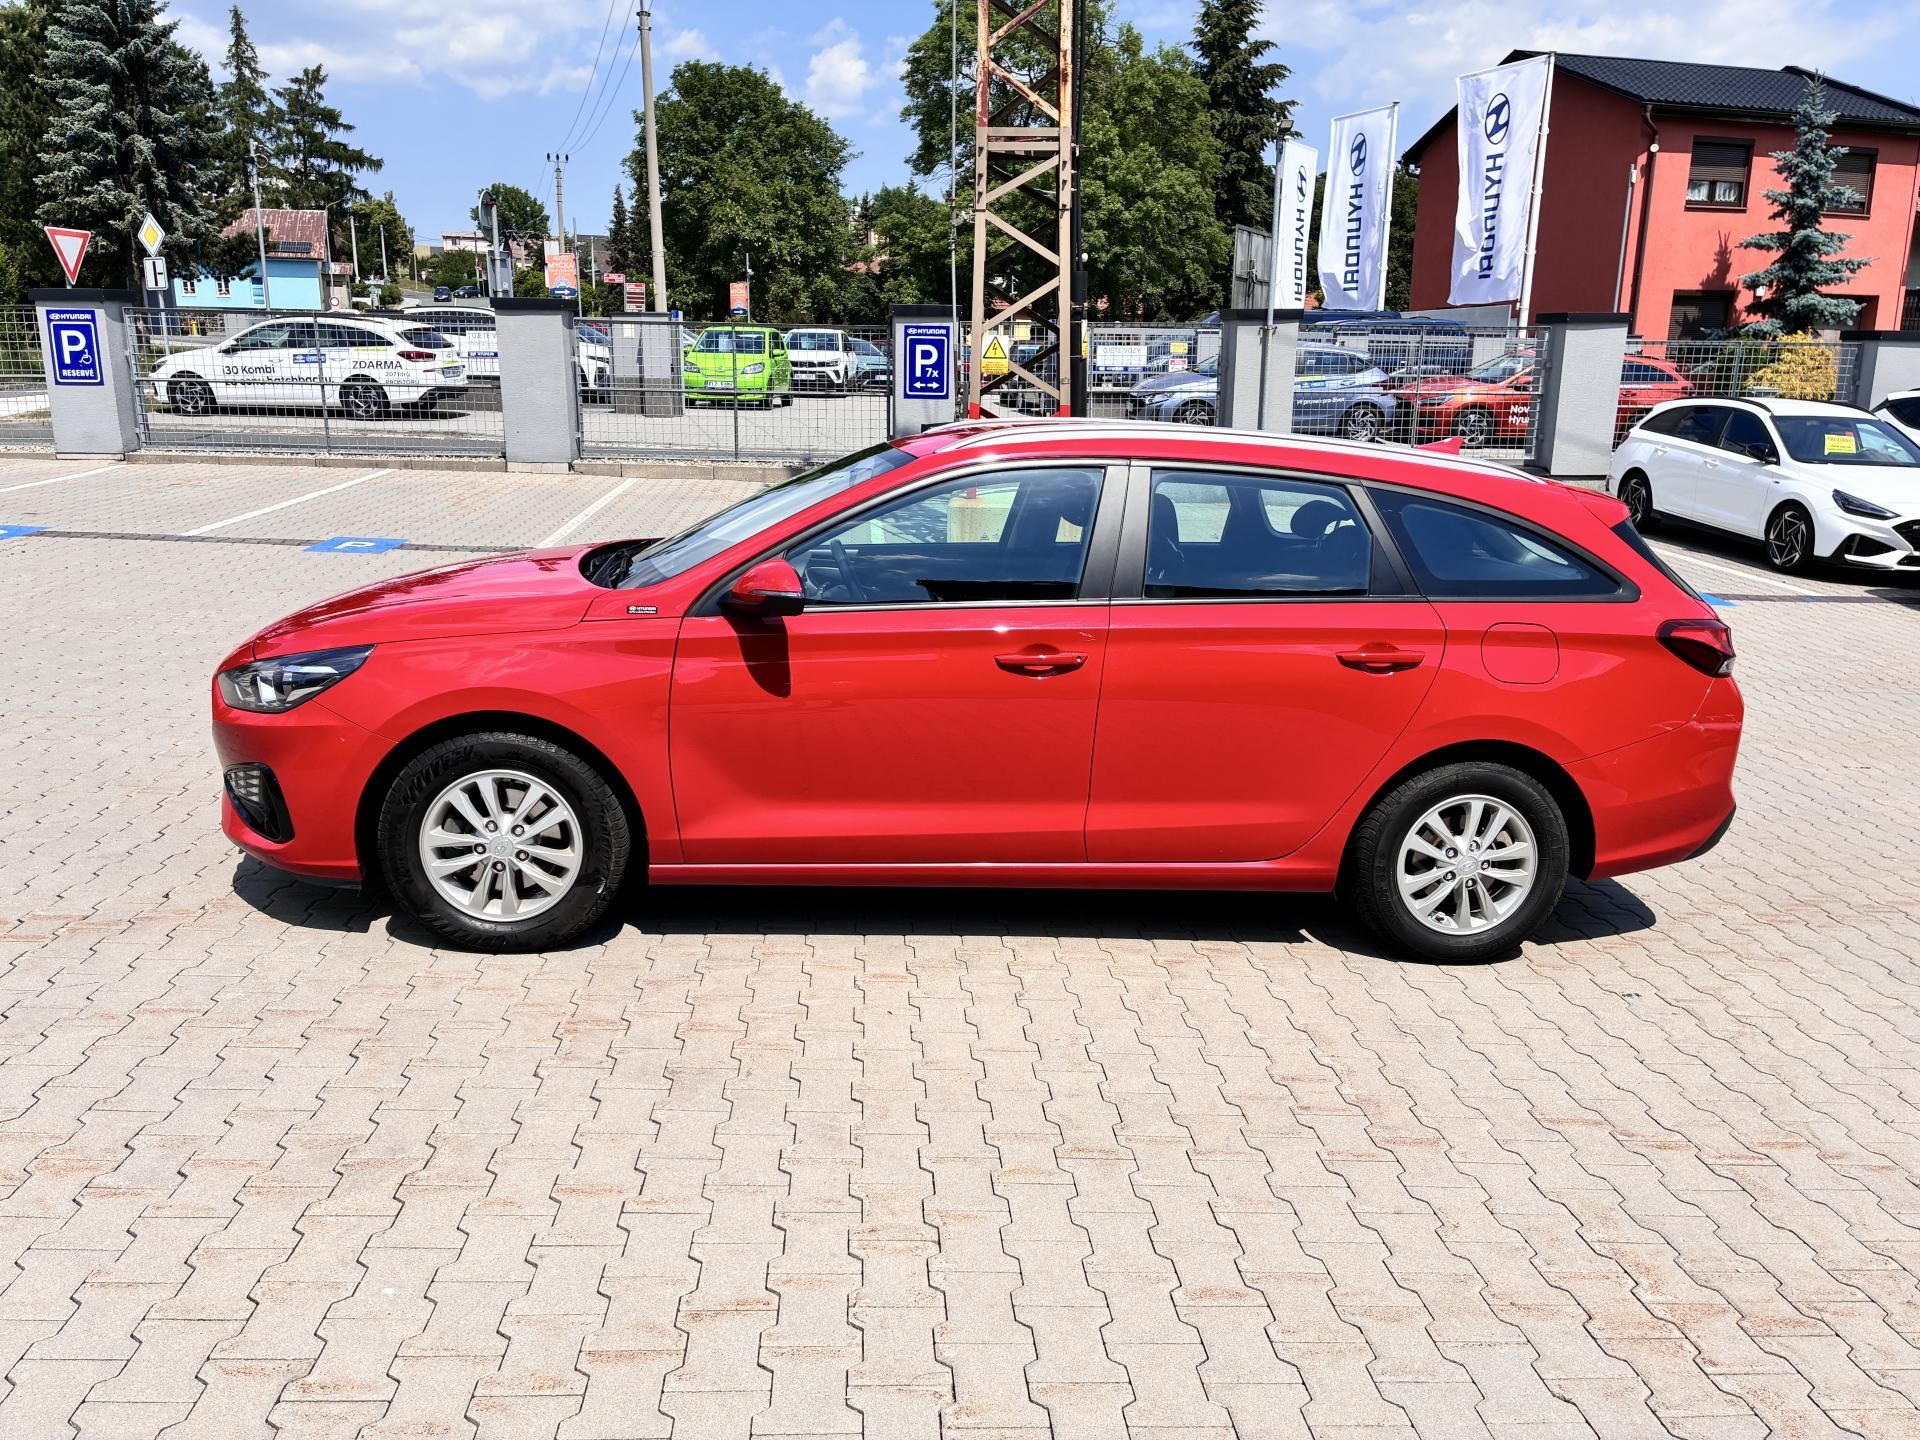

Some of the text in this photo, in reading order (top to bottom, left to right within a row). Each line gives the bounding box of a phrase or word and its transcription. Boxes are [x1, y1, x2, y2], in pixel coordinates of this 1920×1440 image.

[1294, 208, 1305, 302] HYUNDAI
[60, 329, 87, 364] P
[222, 364, 276, 375] i30 Kombi
[352, 360, 403, 370] ZDARMA
[915, 344, 939, 378] P
[925, 367, 939, 378] 7x
